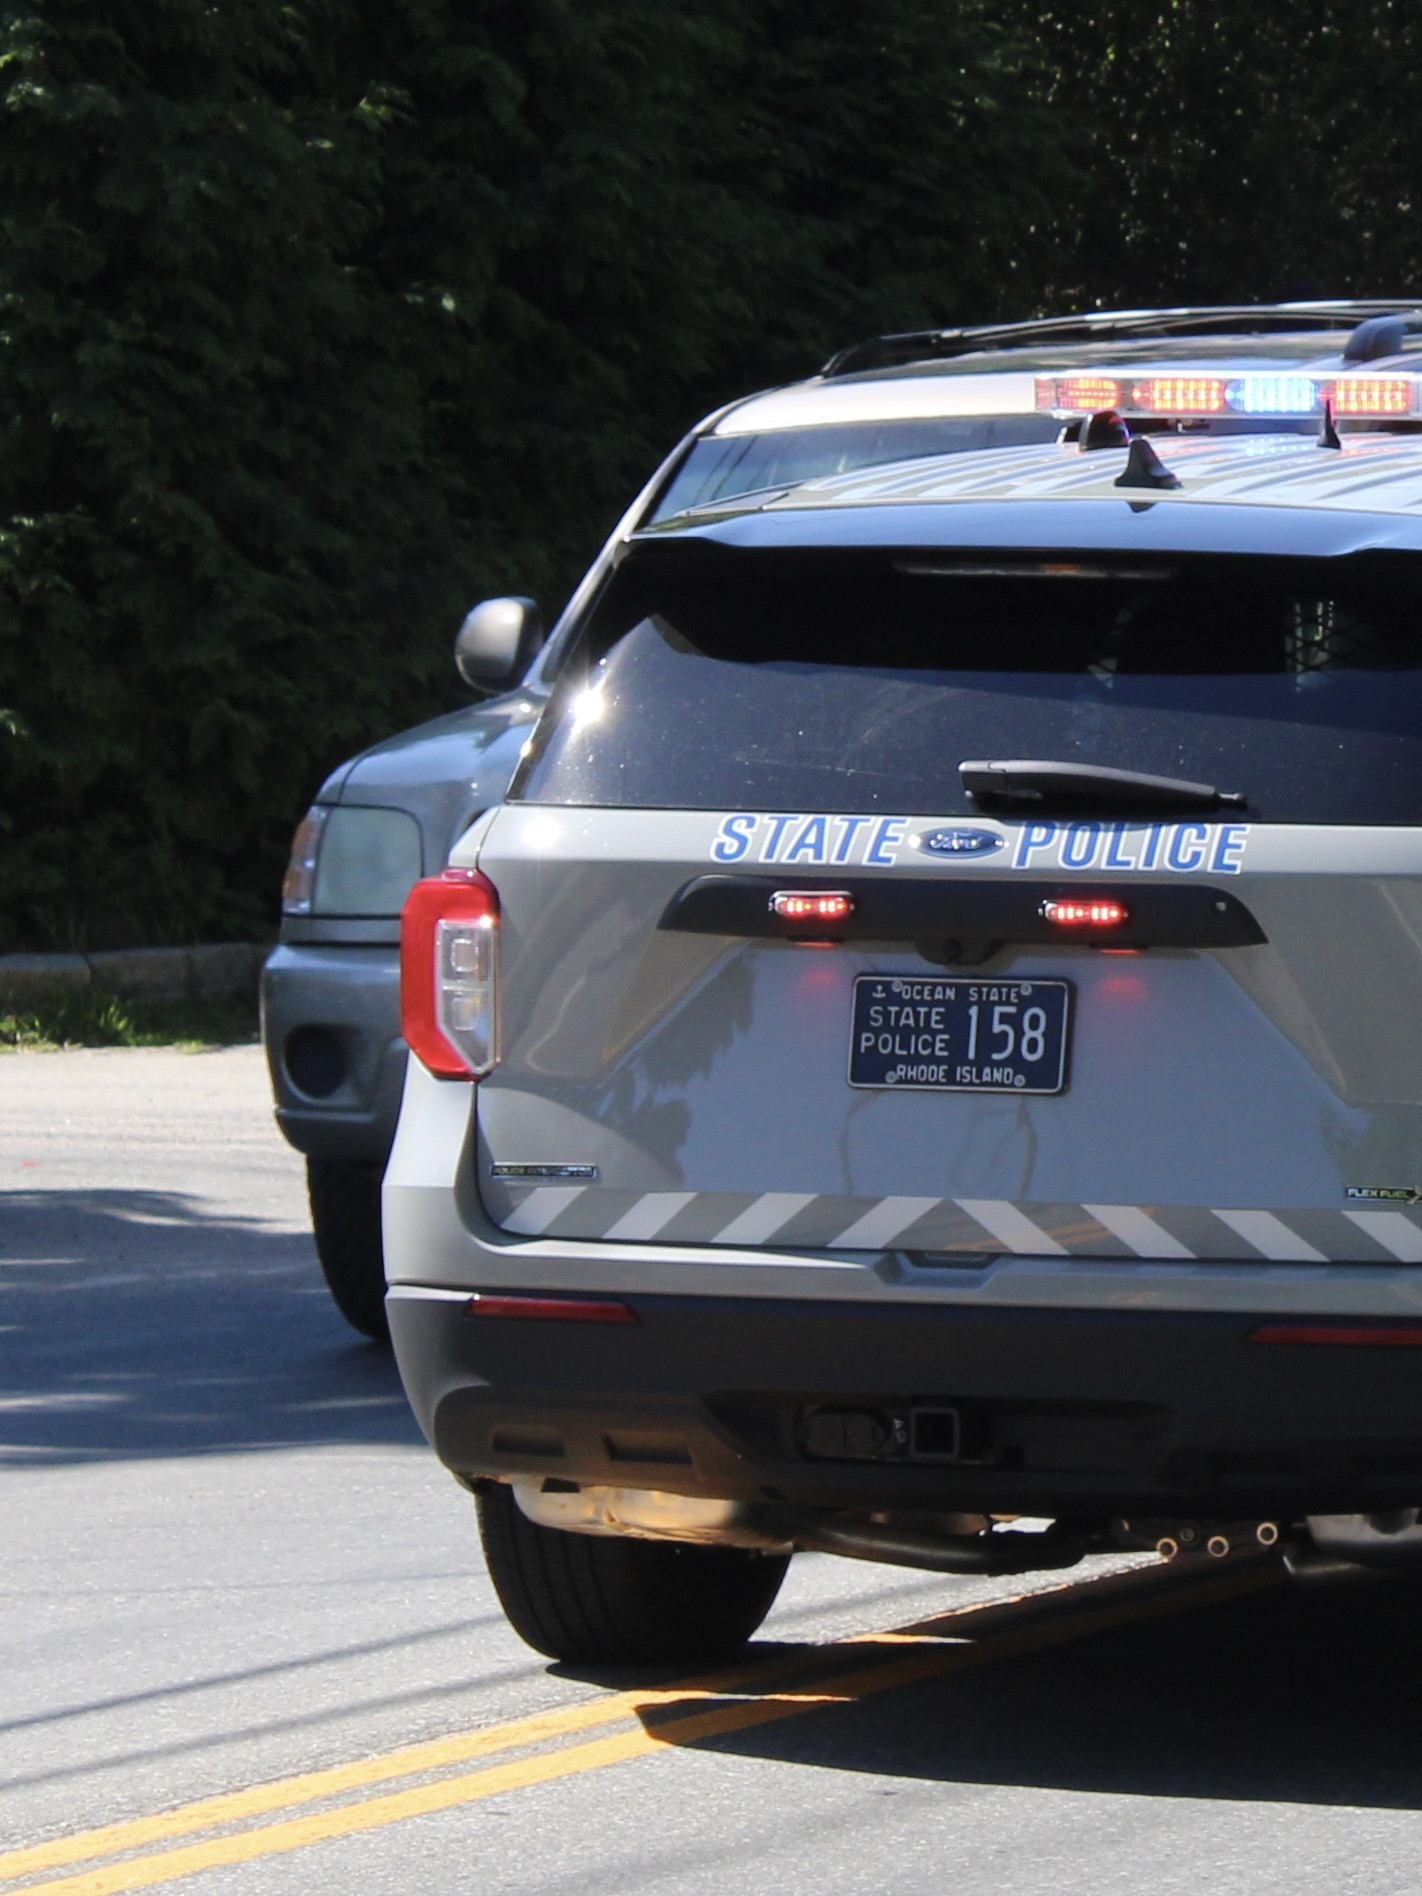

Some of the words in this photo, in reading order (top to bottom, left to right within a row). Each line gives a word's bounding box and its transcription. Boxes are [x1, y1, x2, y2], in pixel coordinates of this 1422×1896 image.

[710, 813, 908, 866] STATE
[1011, 821, 1249, 874] POLICE
[902, 985, 955, 1001] OCEAN
[969, 986, 1019, 1003] STATE
[860, 1032, 950, 1056] POLICE
[869, 1005, 946, 1029] STATE
[967, 1005, 1047, 1062] 158
[896, 1064, 949, 1084] RHODE
[956, 1065, 1014, 1085] ISLAND
